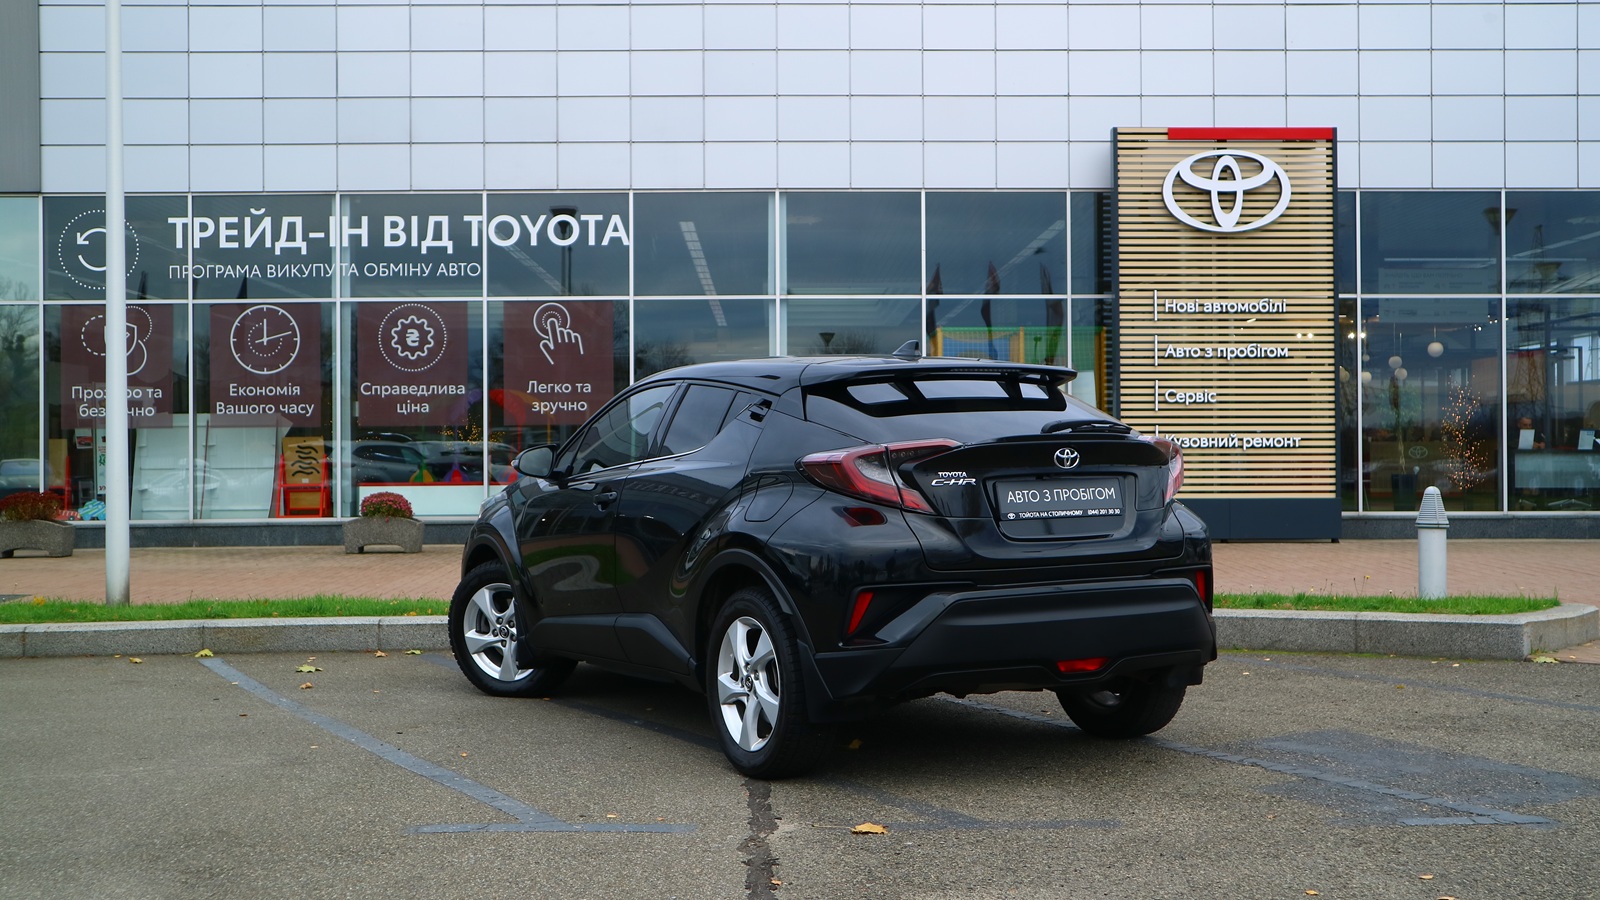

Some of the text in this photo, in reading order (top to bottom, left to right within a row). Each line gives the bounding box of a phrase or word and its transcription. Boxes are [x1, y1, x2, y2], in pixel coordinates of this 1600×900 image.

[168, 208, 630, 255] ТРЕЙД-ІН ВІД TOYOTA
[169, 262, 481, 279] ПРОГРАМА ВИКУПУ ТА ОБМІНУ АВТО
[1165, 298, 1287, 313] Нові автомобілі
[1165, 343, 1289, 361] Авто з пробігом
[146, 388, 162, 399] та
[229, 383, 300, 396] Економія
[360, 382, 466, 398] Справедлива
[527, 380, 591, 394] Легко та
[1165, 389, 1217, 406] Сервіс
[79, 404, 155, 417] безчно
[217, 402, 315, 417] Вашого часу
[397, 400, 430, 414] ціна
[532, 401, 588, 415] зручно
[1243, 436, 1302, 451] ремонт
[931, 478, 977, 487] C-HR
[938, 471, 968, 479] TOYOTA
[1007, 490, 1040, 504] АВТО
[1054, 487, 1117, 502] ПРОБІГОМ
